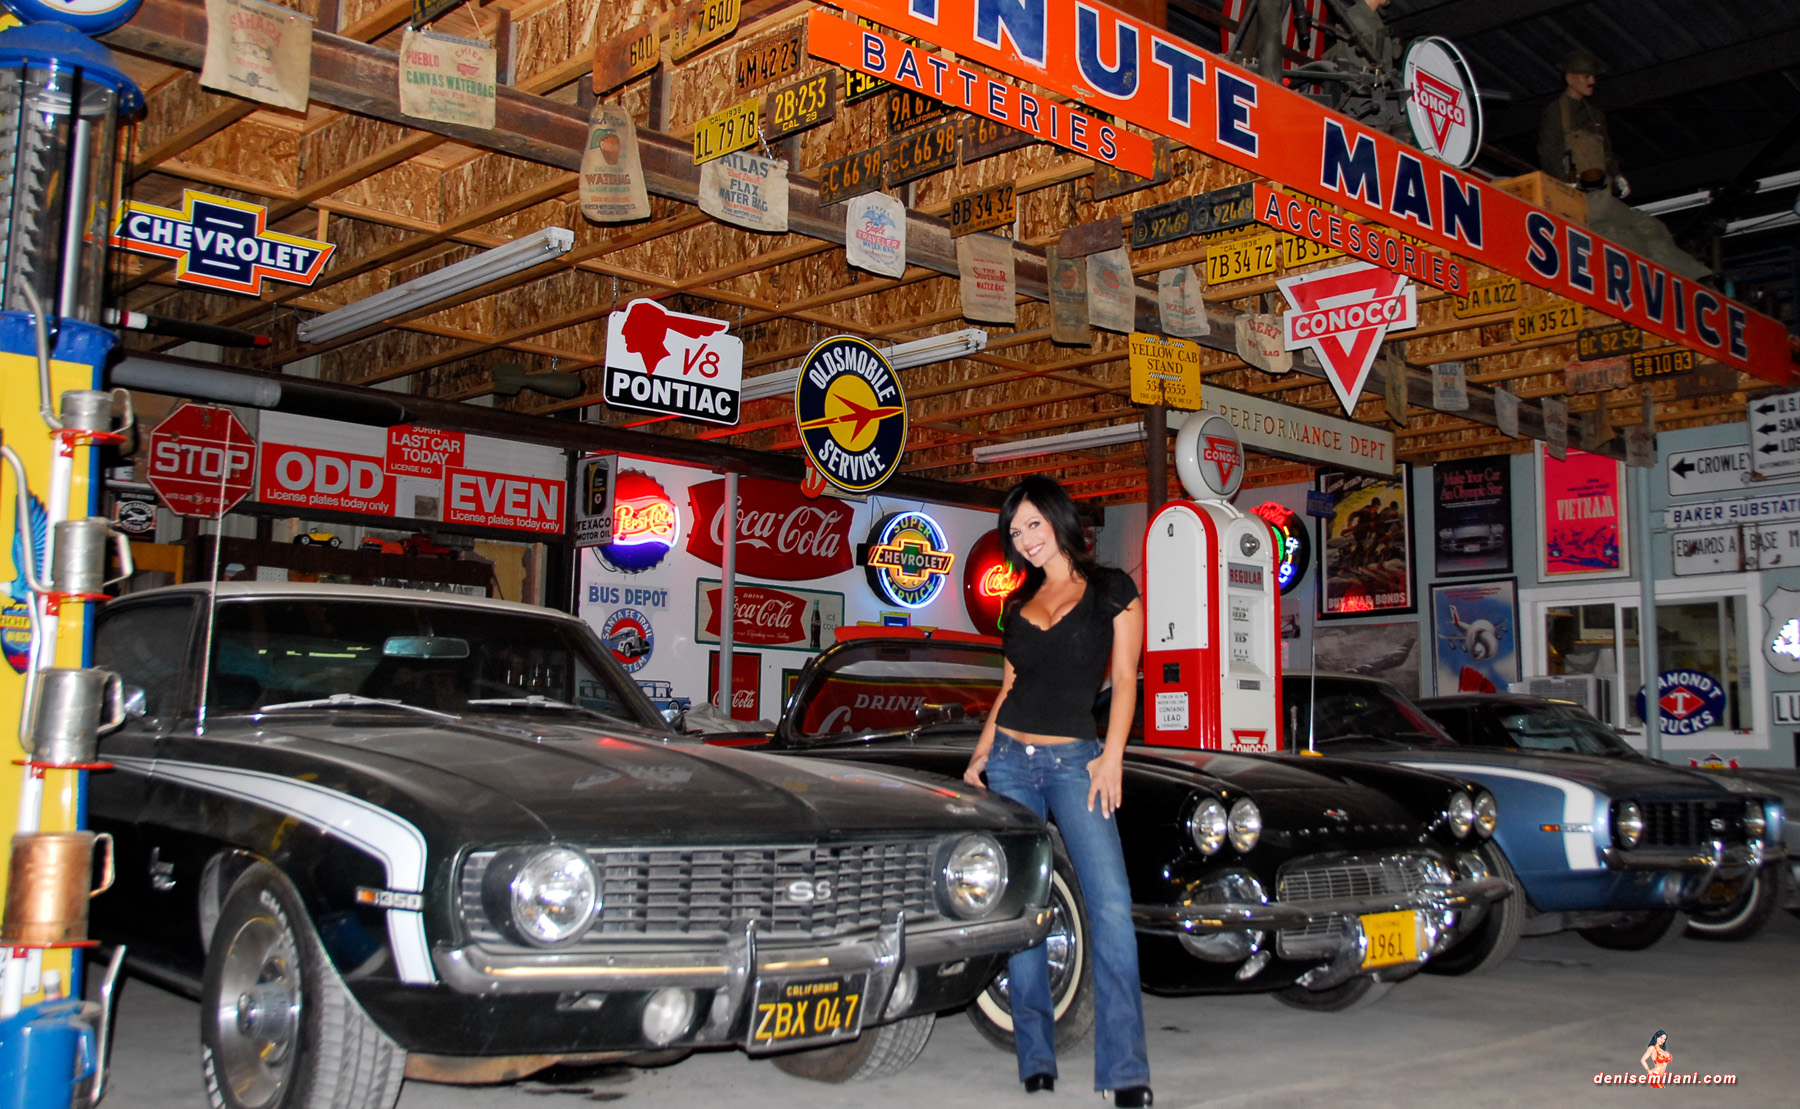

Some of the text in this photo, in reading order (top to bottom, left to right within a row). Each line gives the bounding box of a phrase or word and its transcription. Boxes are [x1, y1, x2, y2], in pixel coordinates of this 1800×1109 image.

[406, 50, 441, 67] PUEBLO
[629, 33, 653, 67] 640
[781, 38, 799, 71] 23
[406, 71, 445, 87] CANVAS
[862, 31, 1118, 161] BATTERIES
[719, 120, 735, 149] 79
[740, 110, 755, 141] 78
[783, 119, 800, 132] CAL
[720, 153, 769, 178] ATLAS
[730, 178, 758, 197] FLAX
[906, 0, 1750, 362] NUTE MAN SERVICE
[719, 187, 749, 206] WATER
[751, 197, 768, 212] BAG
[976, 193, 992, 220] 34
[997, 186, 1013, 214] 32
[857, 231, 899, 248] TRAVELER
[865, 221, 886, 235] Eagle
[128, 214, 311, 273] CHEVROLET
[1263, 192, 1461, 292] ACCESSORIES
[1210, 244, 1273, 280] 7B 34 72
[1295, 300, 1402, 337] CONOCO
[1540, 311, 1557, 332] 35
[1560, 307, 1578, 328] 21
[682, 343, 720, 379] V8
[1131, 343, 1198, 363] YELLOW CAB
[808, 346, 896, 402] OLDSMOBILE
[1147, 358, 1184, 374] STAND
[612, 372, 731, 417] PONTIAC
[391, 431, 461, 454] LAST CAR
[1220, 404, 1386, 461] PERFORMANCE DEPT
[155, 441, 250, 479] STOP
[401, 447, 450, 465] TODAY
[818, 439, 886, 481] SERVICE
[1204, 449, 1241, 465] CONOCO
[275, 451, 384, 499] ODD
[390, 463, 420, 474] LICENSE
[1465, 469, 1484, 484] Your
[1484, 467, 1502, 480] Car
[267, 488, 390, 513] License plates today only
[451, 473, 559, 520] EVEN
[1556, 495, 1615, 520] VIETNAM
[450, 510, 560, 532] License plates today only
[577, 517, 612, 532] TEXACO
[710, 495, 846, 558] Coca-Cola
[1673, 506, 1723, 523] BAKER
[600, 530, 612, 538] OIL
[893, 515, 932, 539] SUPER
[1750, 531, 1778, 550] BASE
[877, 550, 945, 570] CHEVROLET
[1229, 568, 1263, 585] REGULAR
[589, 585, 668, 608] BUS DEPOT
[888, 577, 935, 604] SERVICE
[1375, 592, 1406, 606] BONDS
[602, 609, 654, 640] SANTA FE TRAIL
[733, 596, 795, 629] oca-Cola
[622, 655, 648, 673] STEM
[1641, 672, 1711, 695] AMOND
[854, 694, 927, 711] DRINK
[1163, 714, 1181, 722] LEAD
[1660, 710, 1715, 734] RUCKS
[1231, 743, 1267, 753] CONOCO
[789, 881, 831, 901] SS
[1370, 933, 1403, 959] 1961
[786, 981, 839, 997] CALIFORNIA
[755, 994, 859, 1040] ZBX 047
